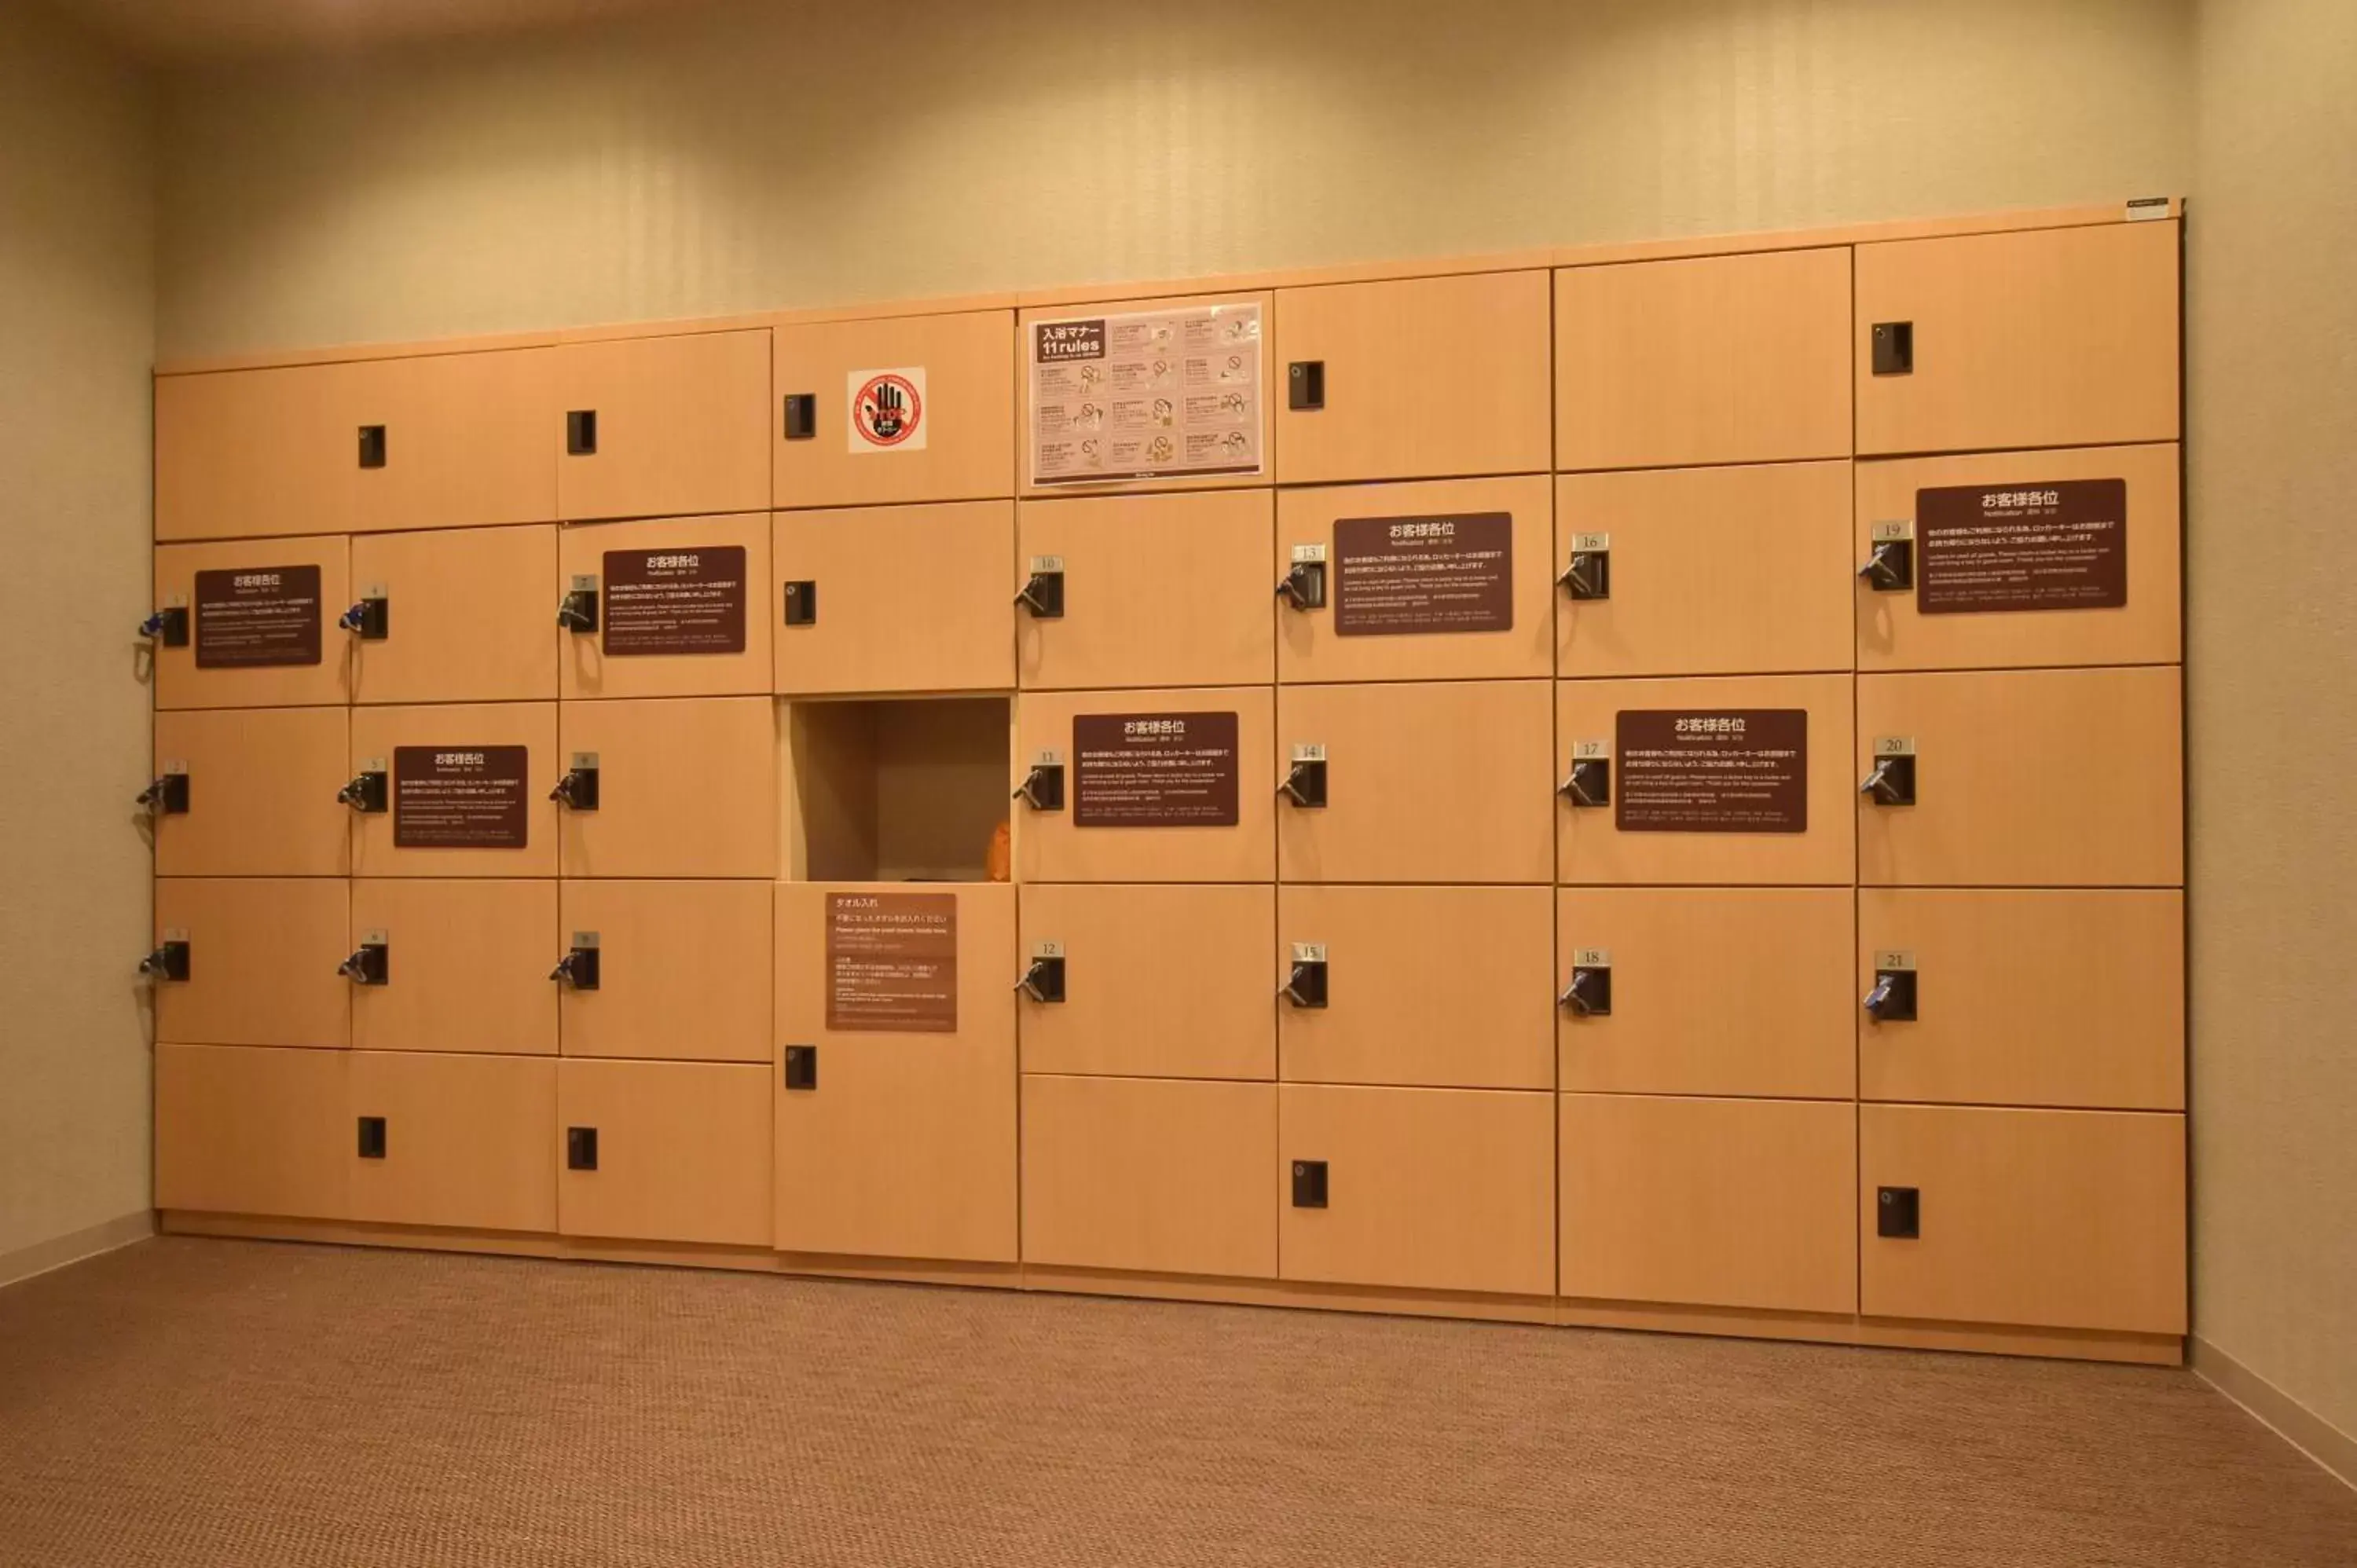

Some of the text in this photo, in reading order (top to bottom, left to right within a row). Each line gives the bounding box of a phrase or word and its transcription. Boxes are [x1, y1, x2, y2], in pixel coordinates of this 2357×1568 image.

[1043, 326, 1100, 340] 入浴マナー
[1981, 490, 2059, 508] お客様各位
[1389, 522, 1456, 538] お客様各位
[1886, 524, 1901, 537] 19
[1584, 536, 1597, 548] 16
[1303, 548, 1316, 559] 13
[1042, 557, 1055, 570] 10
[1124, 720, 1186, 735] お客様各位
[1674, 717, 1747, 732] お客様各位
[1304, 746, 1317, 757] 14
[1584, 743, 1598, 755] 17
[1886, 739, 1902, 752] 20
[1042, 752, 1053, 762] 11
[1043, 943, 1056, 955] 12
[1304, 946, 1318, 958] 15
[1585, 951, 1600, 963] 18
[1886, 954, 1902, 968] 21
